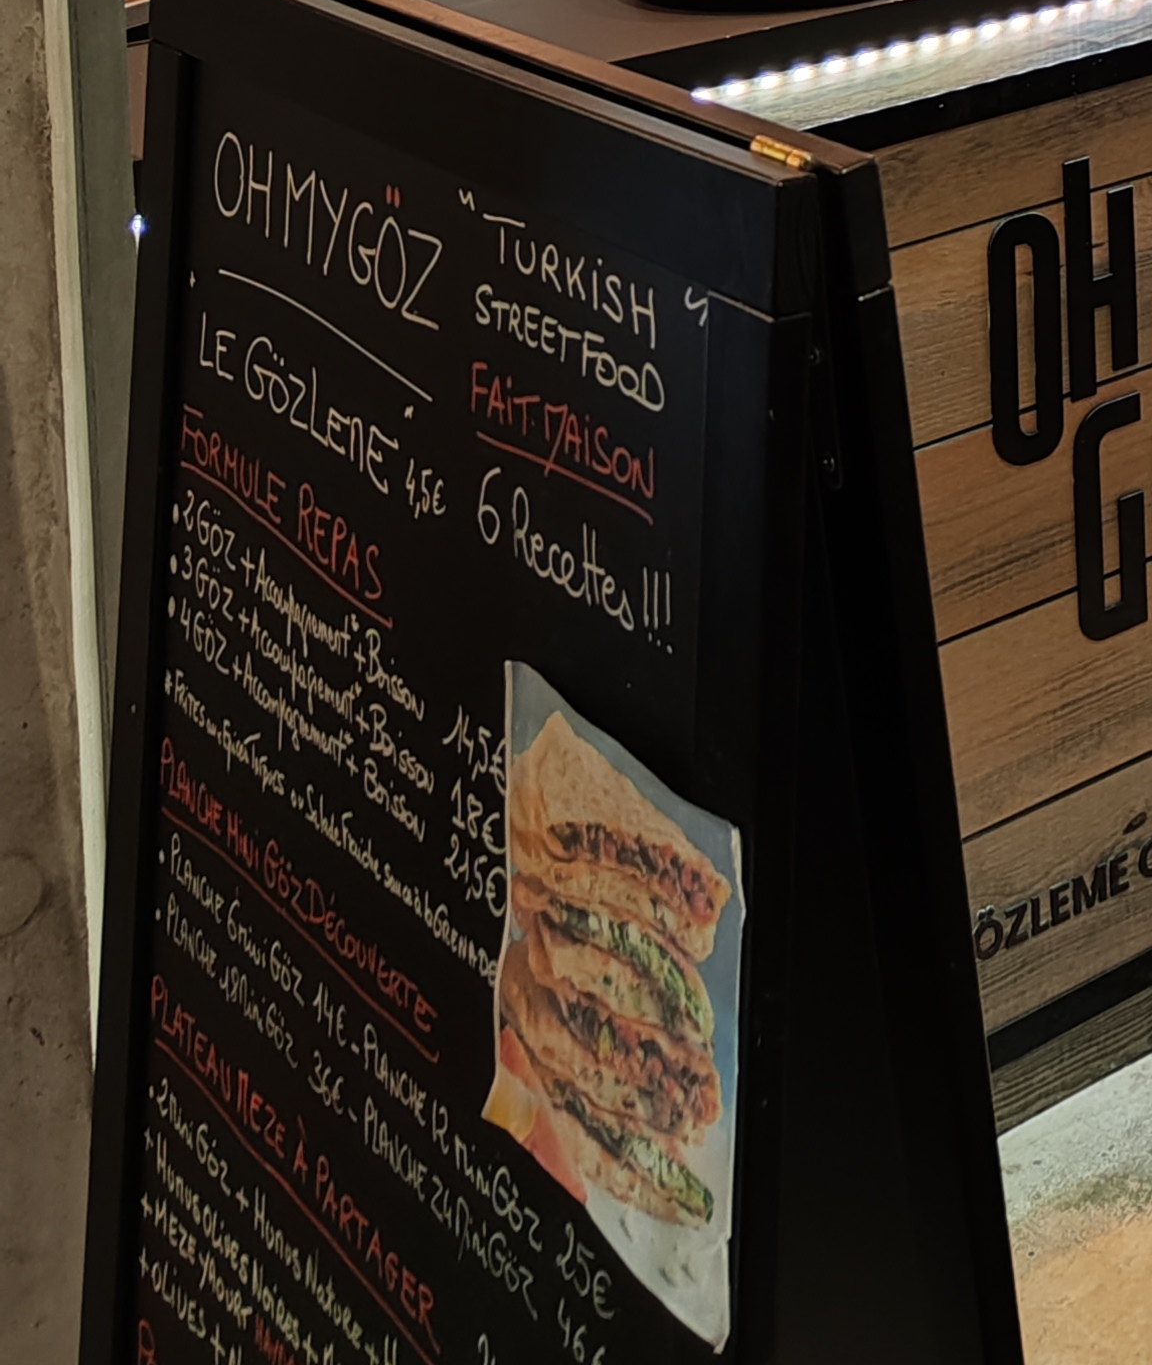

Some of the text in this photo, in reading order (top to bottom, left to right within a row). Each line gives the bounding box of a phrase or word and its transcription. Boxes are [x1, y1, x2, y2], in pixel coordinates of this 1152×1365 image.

[200, 312, 236, 381] LE
[986, 155, 1139, 466] OH
[298, 482, 383, 600] REPAS
[477, 467, 501, 545] 6
